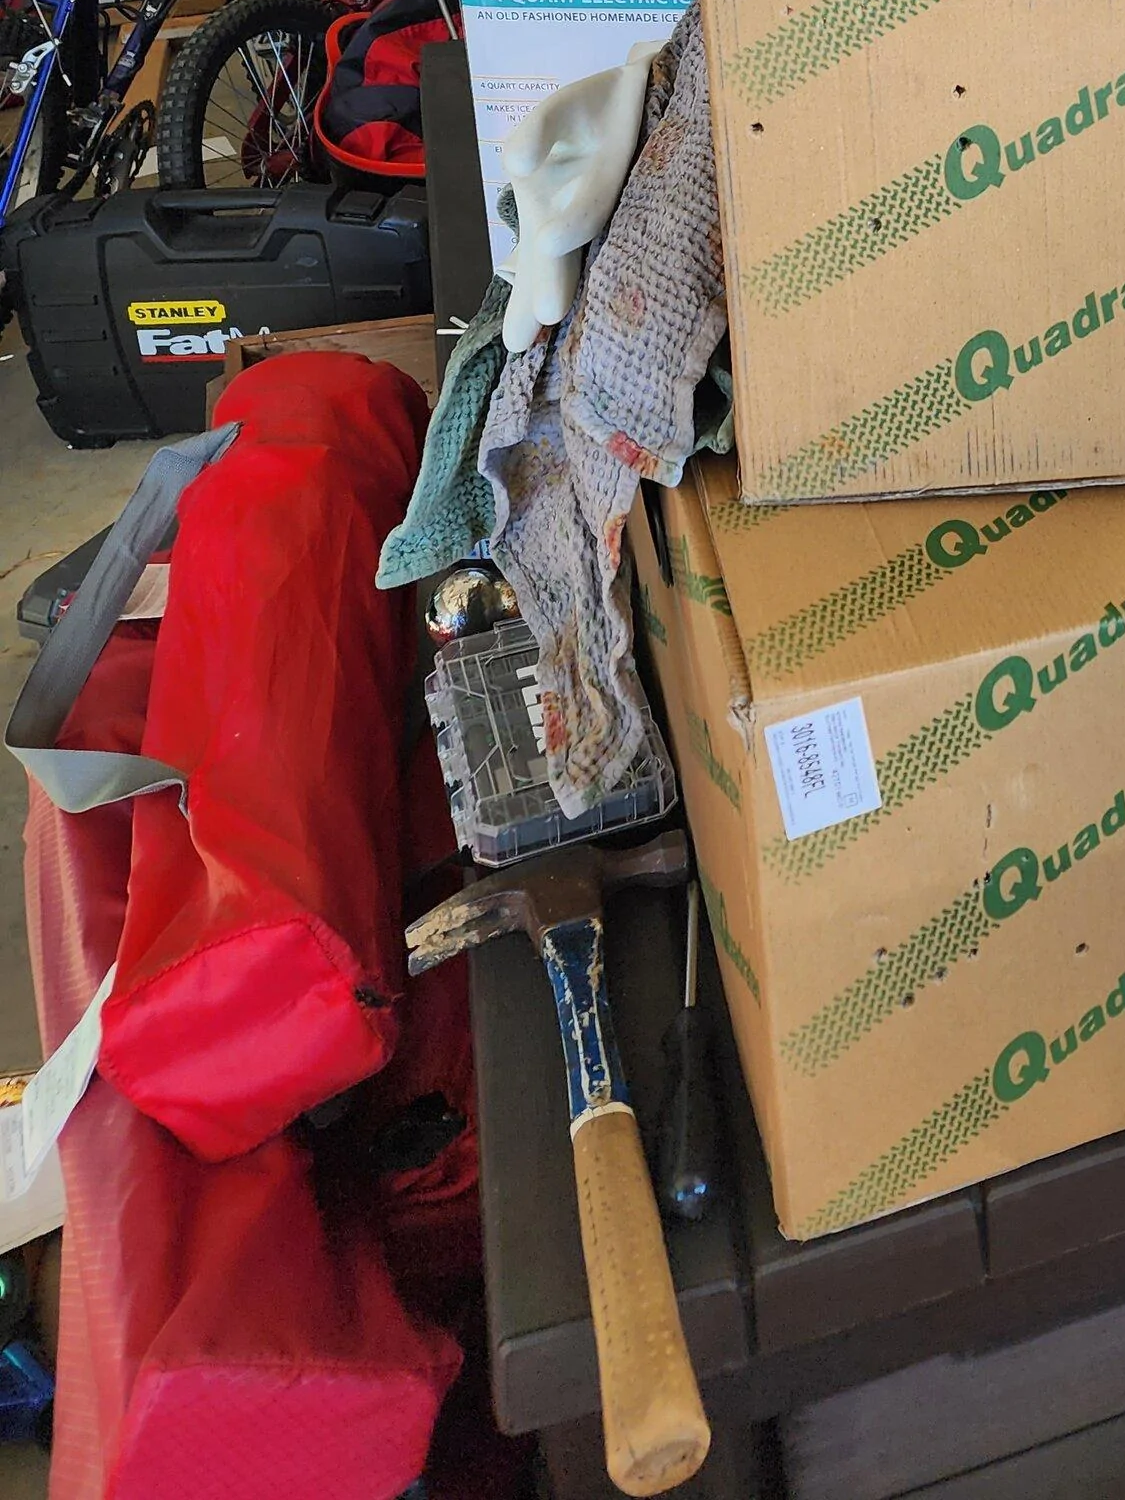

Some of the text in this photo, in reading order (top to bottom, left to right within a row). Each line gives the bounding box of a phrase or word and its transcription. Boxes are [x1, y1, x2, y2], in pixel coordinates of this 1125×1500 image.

[478, 11, 679, 23] AN OLD FASHIONED HOMEMADE ICE
[487, 82, 516, 90] QUART
[519, 83, 560, 91] CAPACITY
[486, 104, 515, 112] MAKES
[518, 105, 531, 113] ICE
[135, 306, 217, 319] STANLEY
